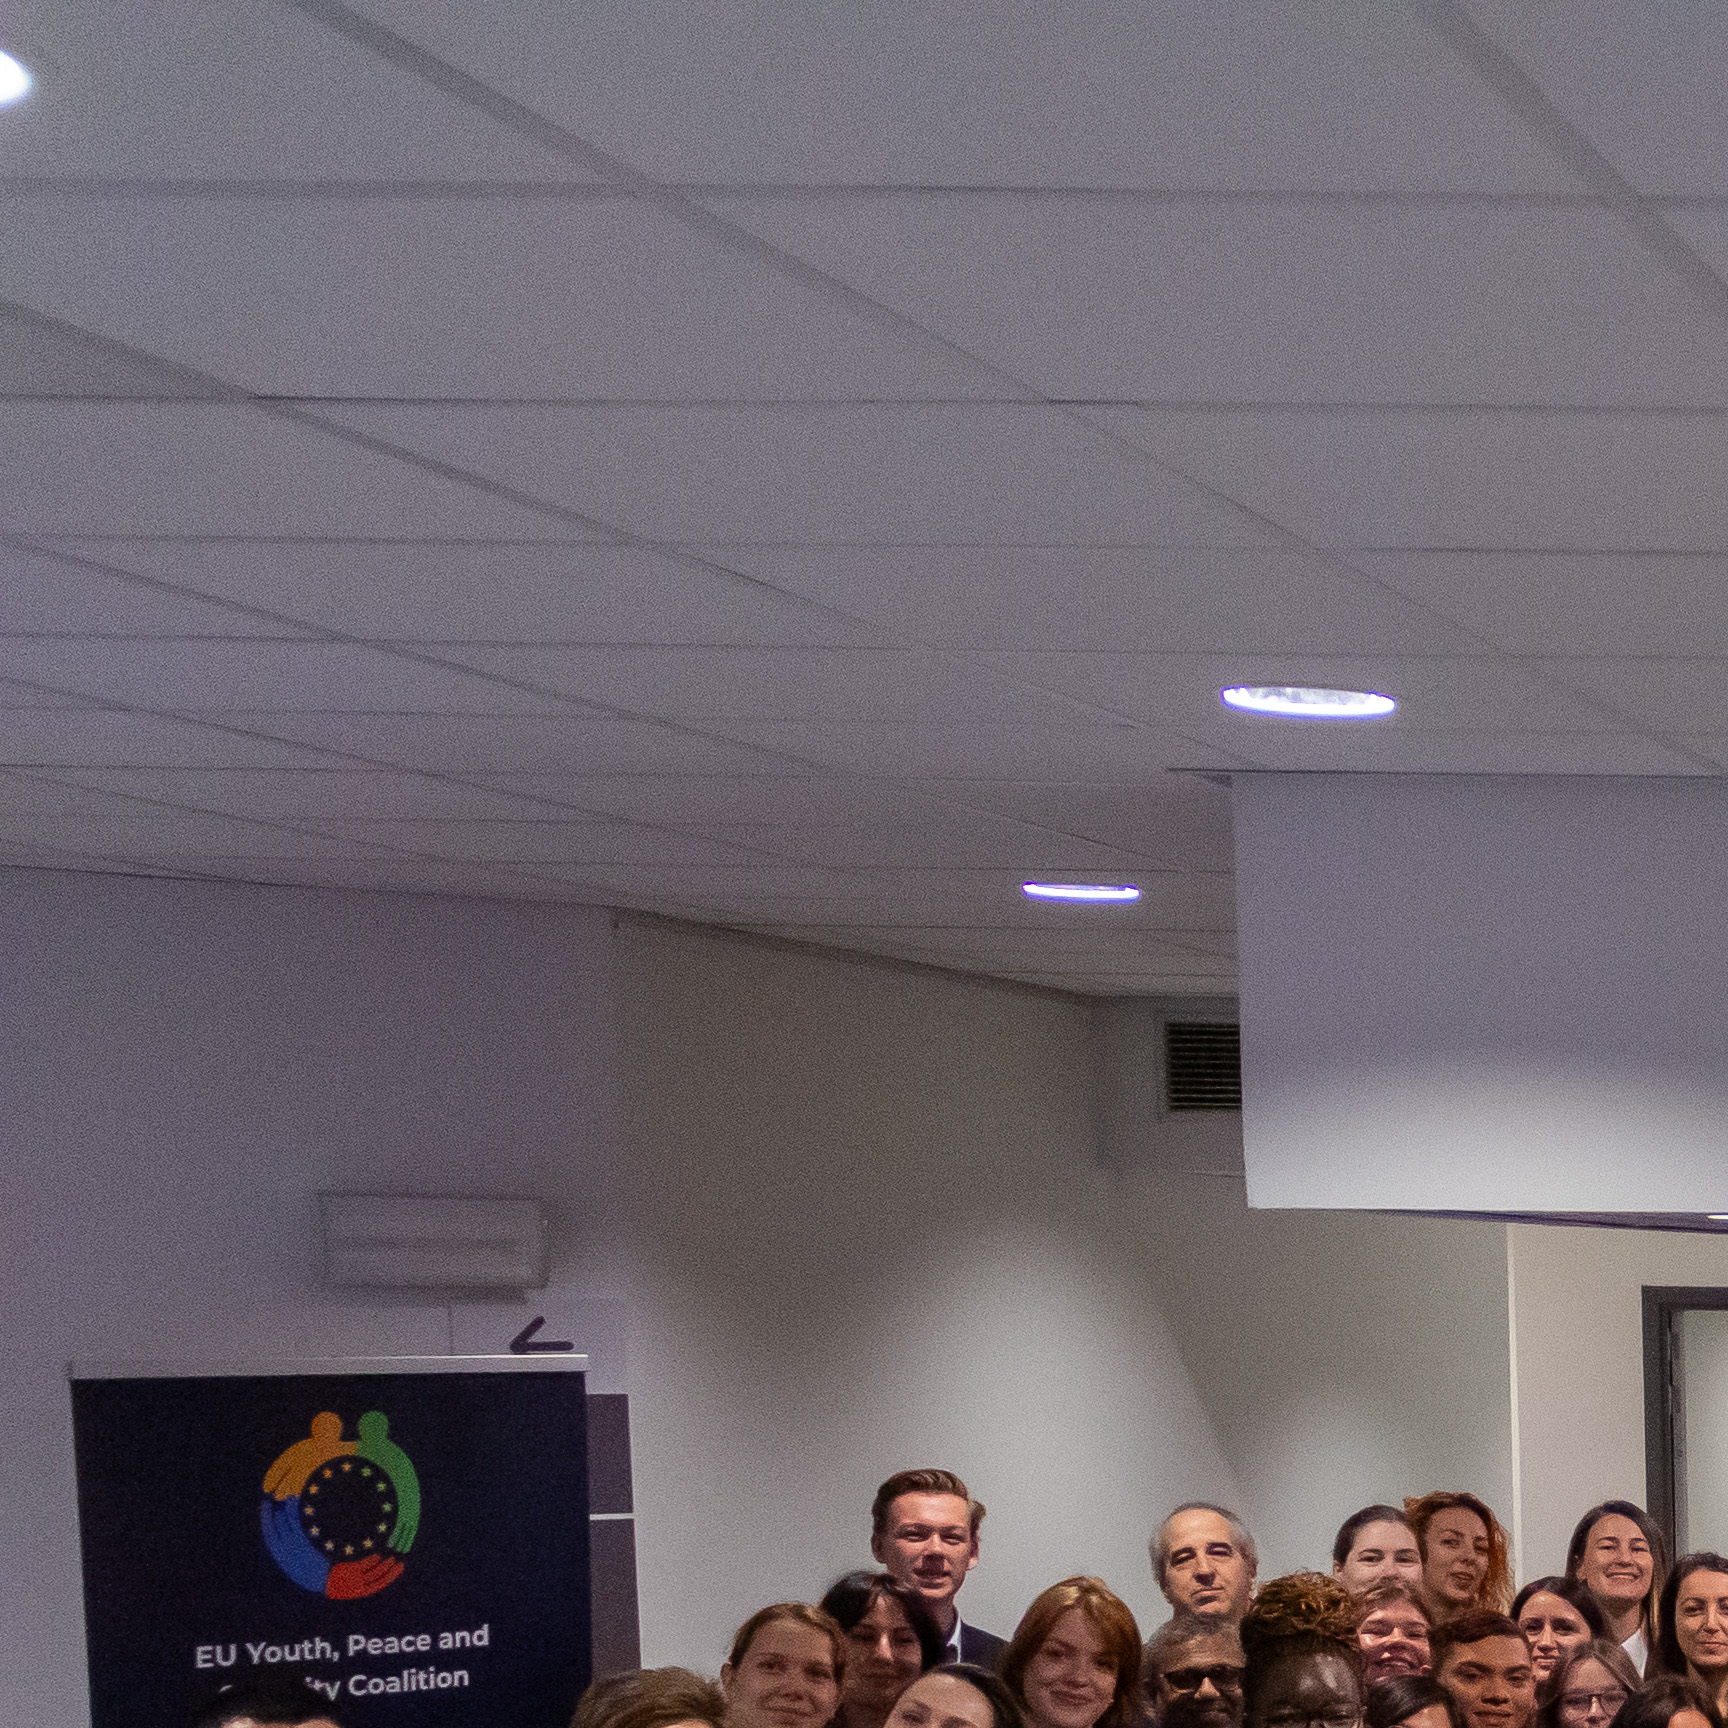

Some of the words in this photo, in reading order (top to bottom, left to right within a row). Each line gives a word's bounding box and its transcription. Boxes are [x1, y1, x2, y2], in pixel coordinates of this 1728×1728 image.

[195, 1644, 237, 1668] EU
[245, 1637, 340, 1664] Youth,
[347, 1634, 431, 1657] Peace
[439, 1623, 490, 1649] and
[348, 1666, 469, 1696] Coalition
